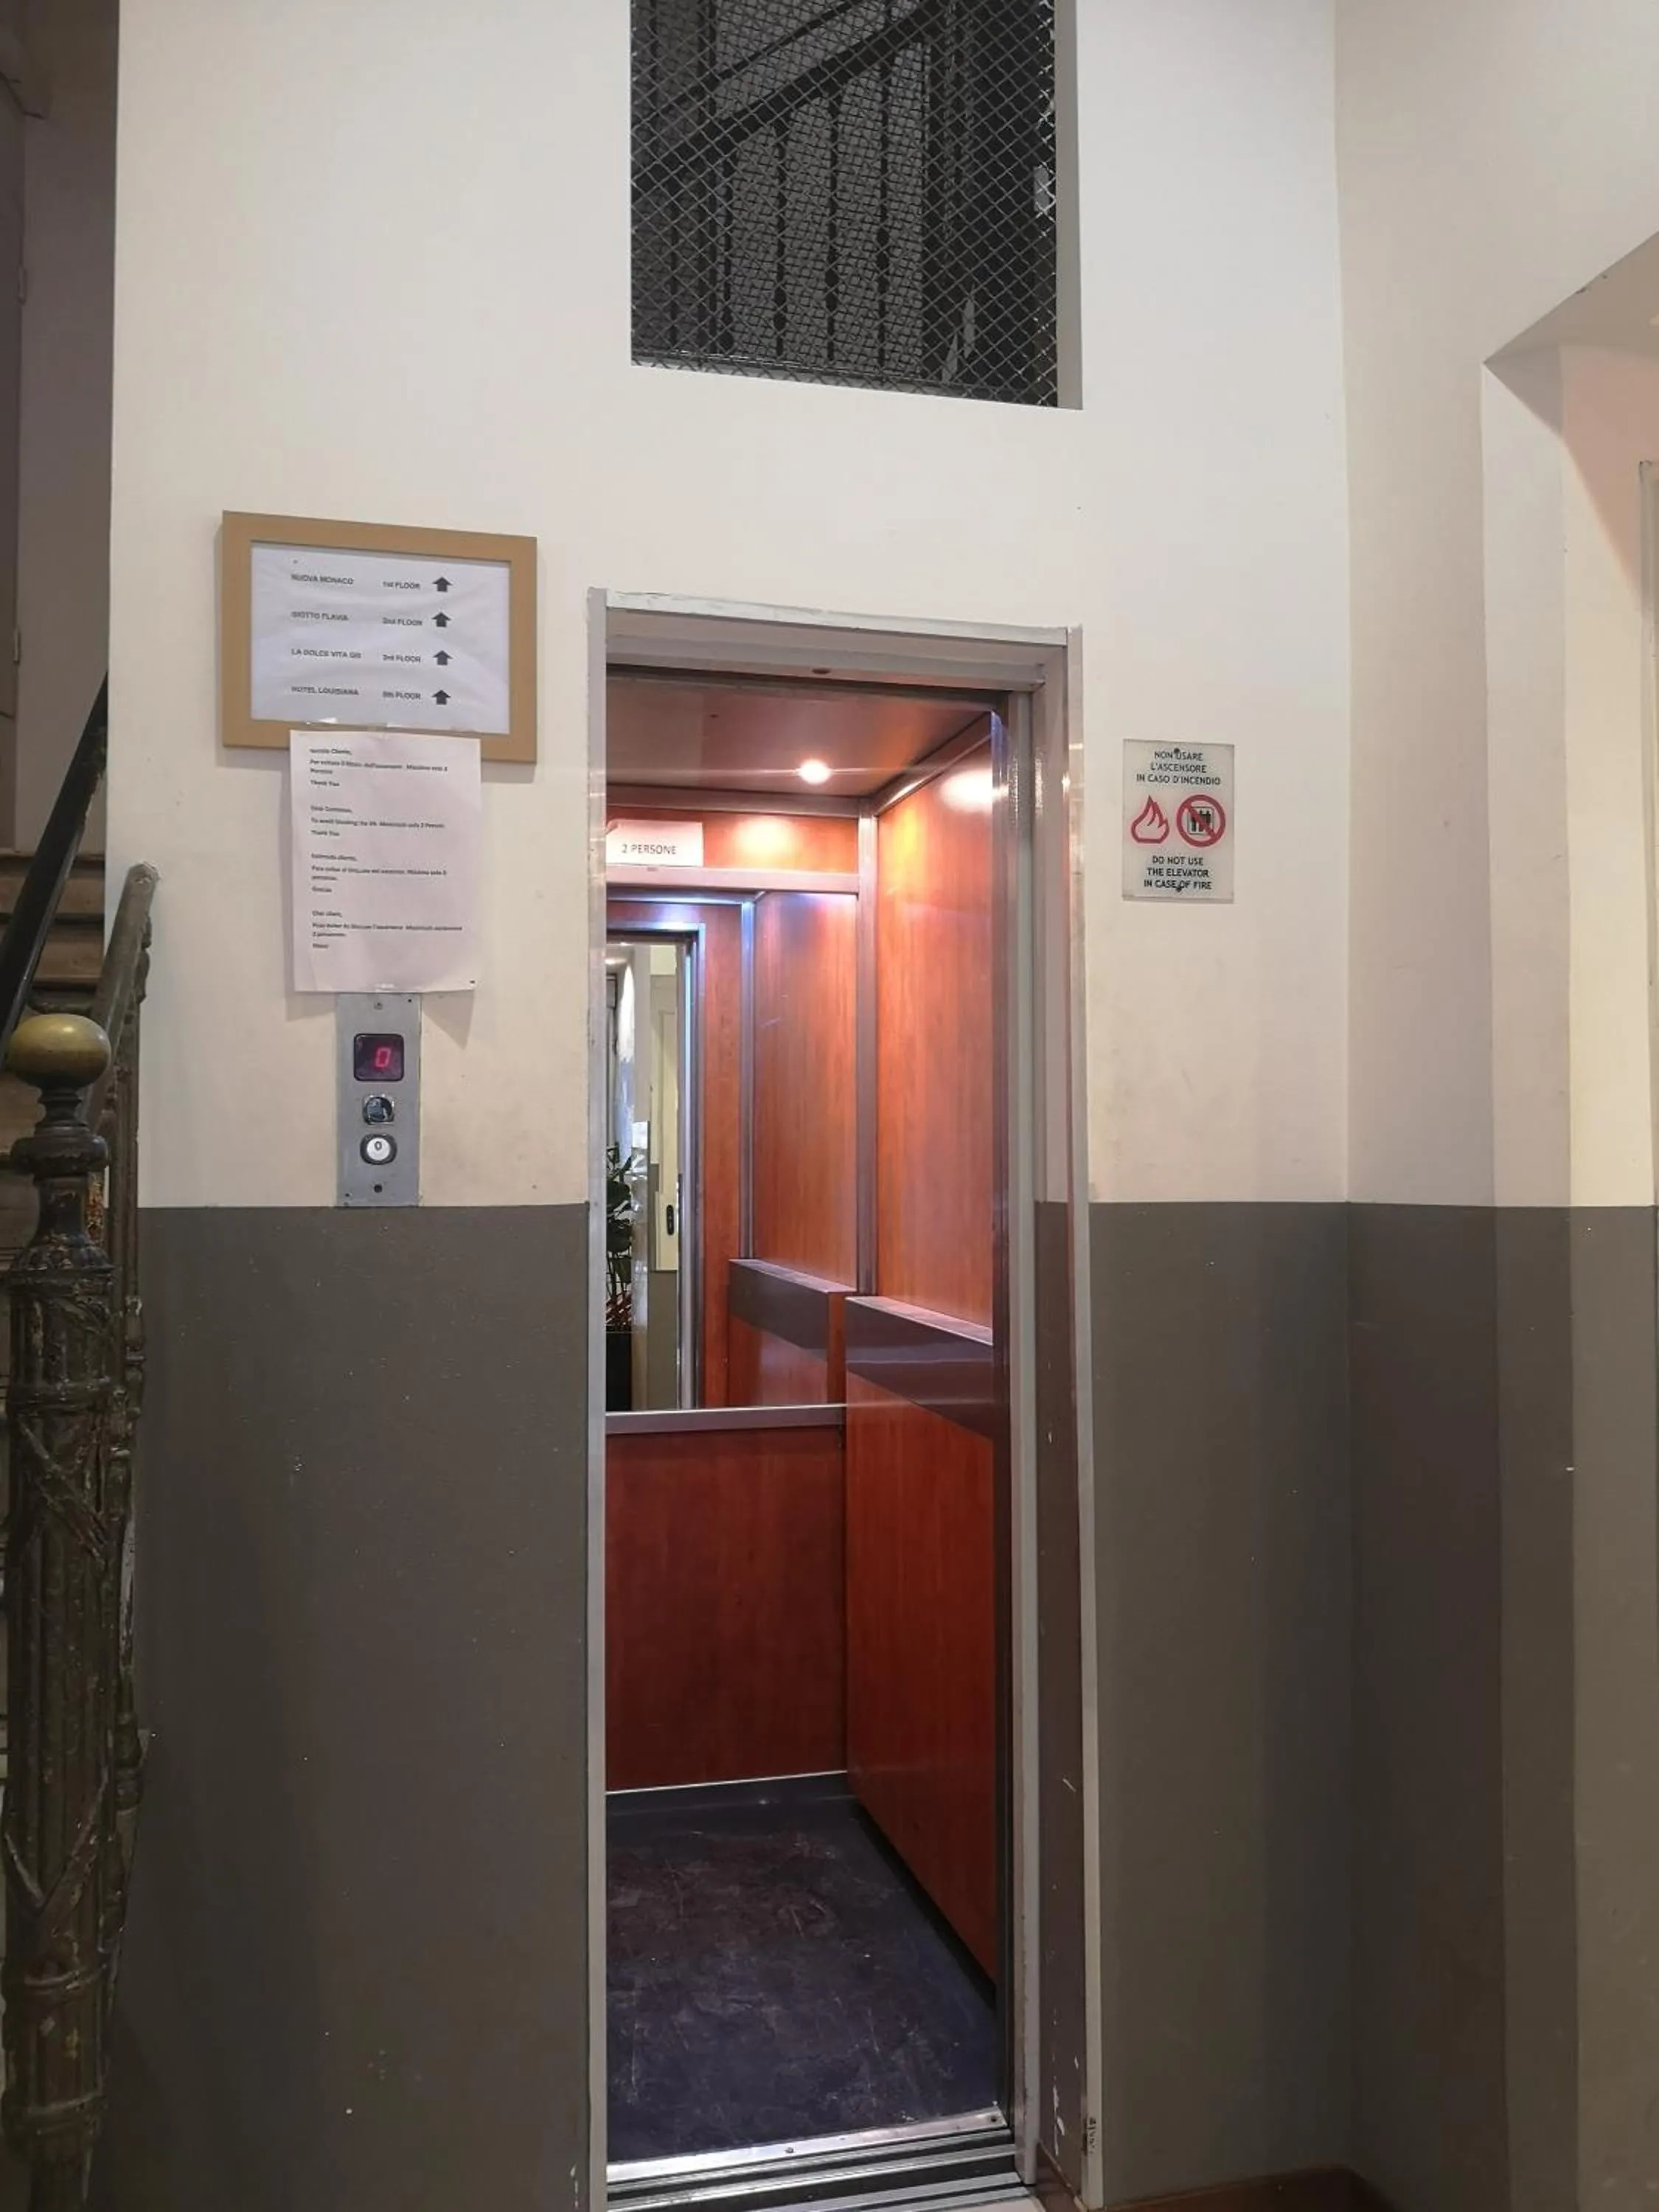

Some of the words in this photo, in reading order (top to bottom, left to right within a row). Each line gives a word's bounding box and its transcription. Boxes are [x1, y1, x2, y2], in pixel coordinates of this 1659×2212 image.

[291, 574, 318, 582] NUOVA
[320, 576, 354, 585] MONACO
[394, 582, 421, 590] FLOOR
[321, 613, 349, 621] FLAVIA
[397, 619, 422, 627] FLOOR
[303, 649, 329, 657] DOLCE
[330, 650, 348, 658] VITA
[395, 654, 422, 663] FLOOR
[291, 686, 317, 694] HOTEL
[318, 686, 359, 695] LOUISIANA
[395, 692, 421, 700] FLOOR
[1154, 751, 1173, 760] NON
[1175, 751, 1203, 760] USARE
[1150, 763, 1207, 773] L'ASCENSORE
[1136, 773, 1146, 782] IN
[1147, 774, 1170, 784] CASO
[1172, 775, 1221, 785] D'INCENDIO
[622, 844, 627, 854] 2
[630, 844, 678, 855] PERSONE
[1152, 855, 1165, 864] DO
[1167, 856, 1185, 865] NOT
[1188, 856, 1204, 866] USE
[1147, 867, 1165, 877] THE
[1166, 868, 1209, 878] ELEVATOR
[1144, 879, 1152, 888] IN
[1155, 880, 1177, 889] CASE
[1178, 880, 1190, 890] OF
[1193, 881, 1212, 890] FIRE
[375, 1047, 392, 1068] 0
[374, 1141, 382, 1151] 0
